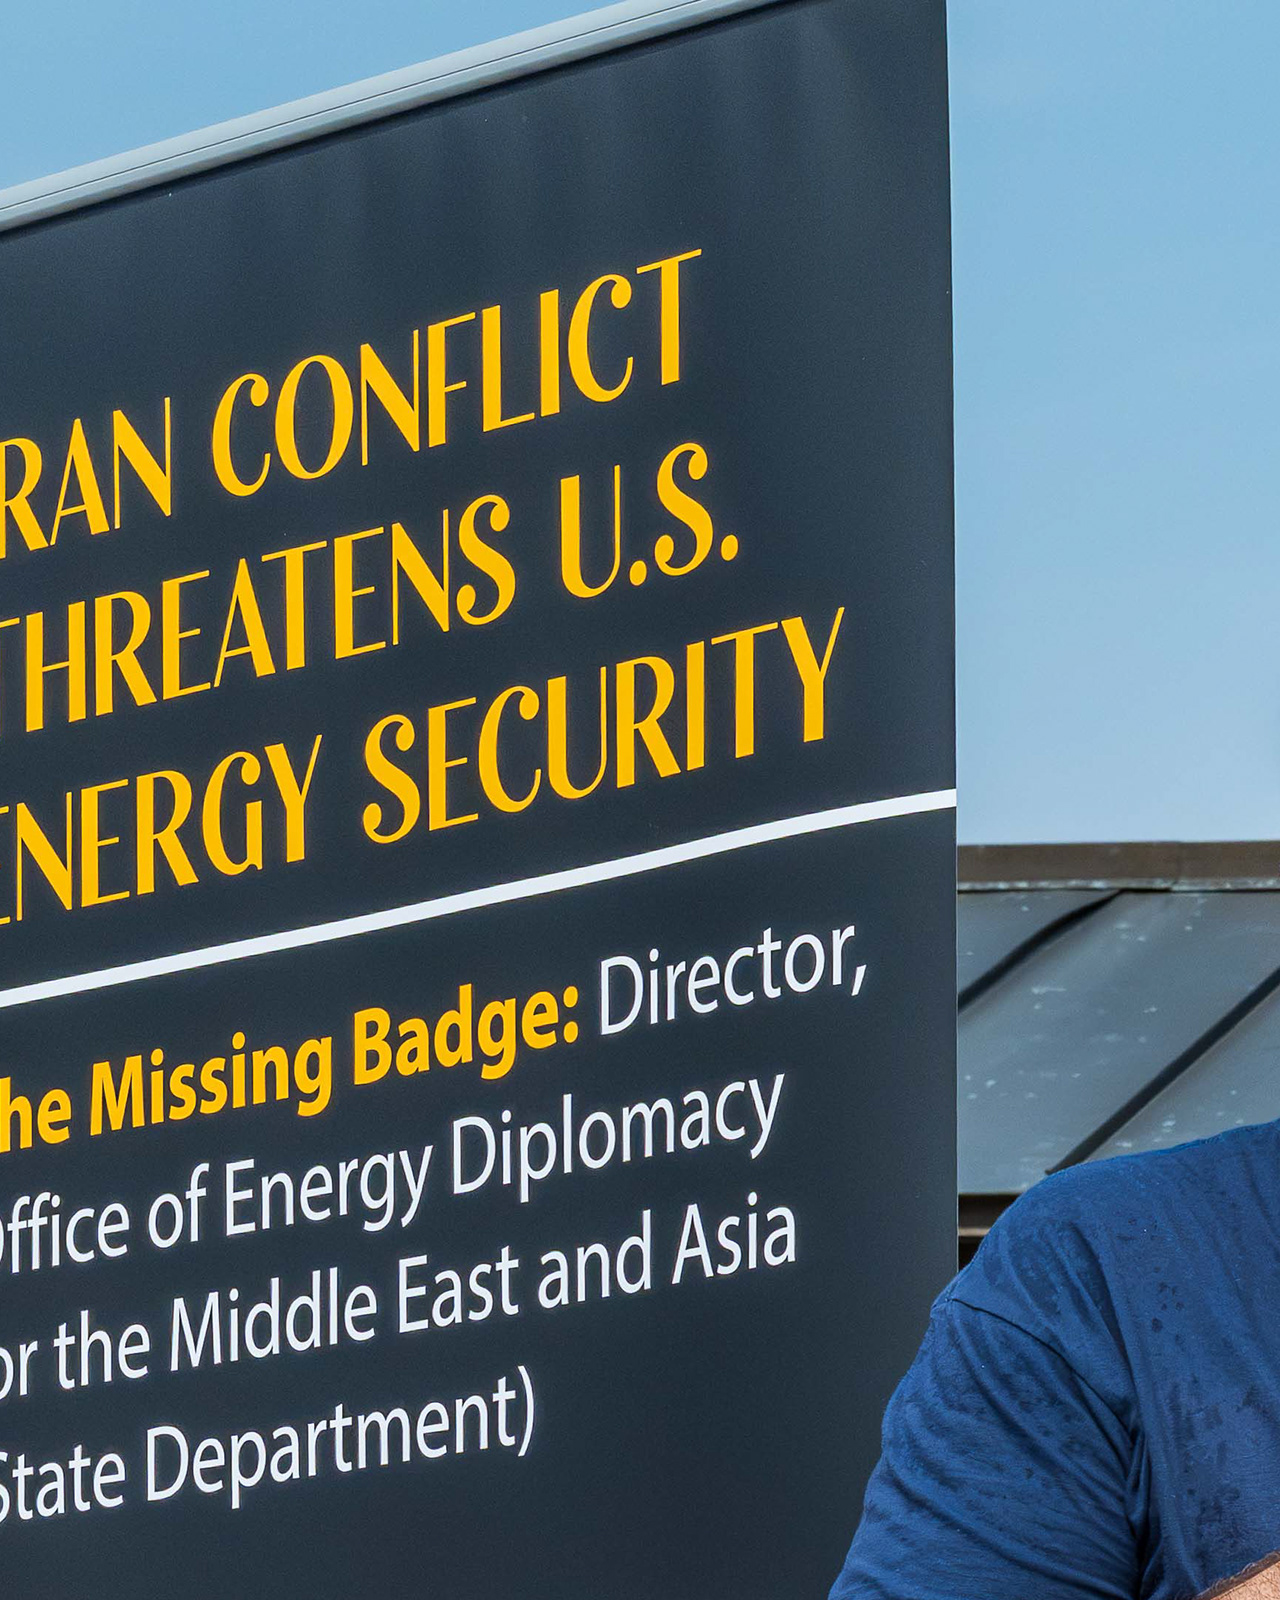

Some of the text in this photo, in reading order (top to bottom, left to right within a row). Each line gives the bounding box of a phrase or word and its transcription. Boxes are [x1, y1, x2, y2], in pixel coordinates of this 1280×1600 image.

[212, 249, 702, 496] CONFLICT
[561, 443, 738, 598] U.S.
[363, 607, 845, 844] SECURITY
[90, 1032, 332, 1136] Missing
[354, 984, 578, 1080] Badge:
[601, 926, 866, 1035] Director,
[148, 1163, 209, 1248] of
[226, 1145, 433, 1236] Energy
[453, 1074, 784, 1206] Diplomacy
[53, 1310, 150, 1389] the
[171, 1267, 377, 1371] Middle
[399, 1246, 519, 1333] East
[538, 1209, 651, 1308] and
[672, 1192, 795, 1284] Asia
[147, 1366, 534, 1509] Department)
